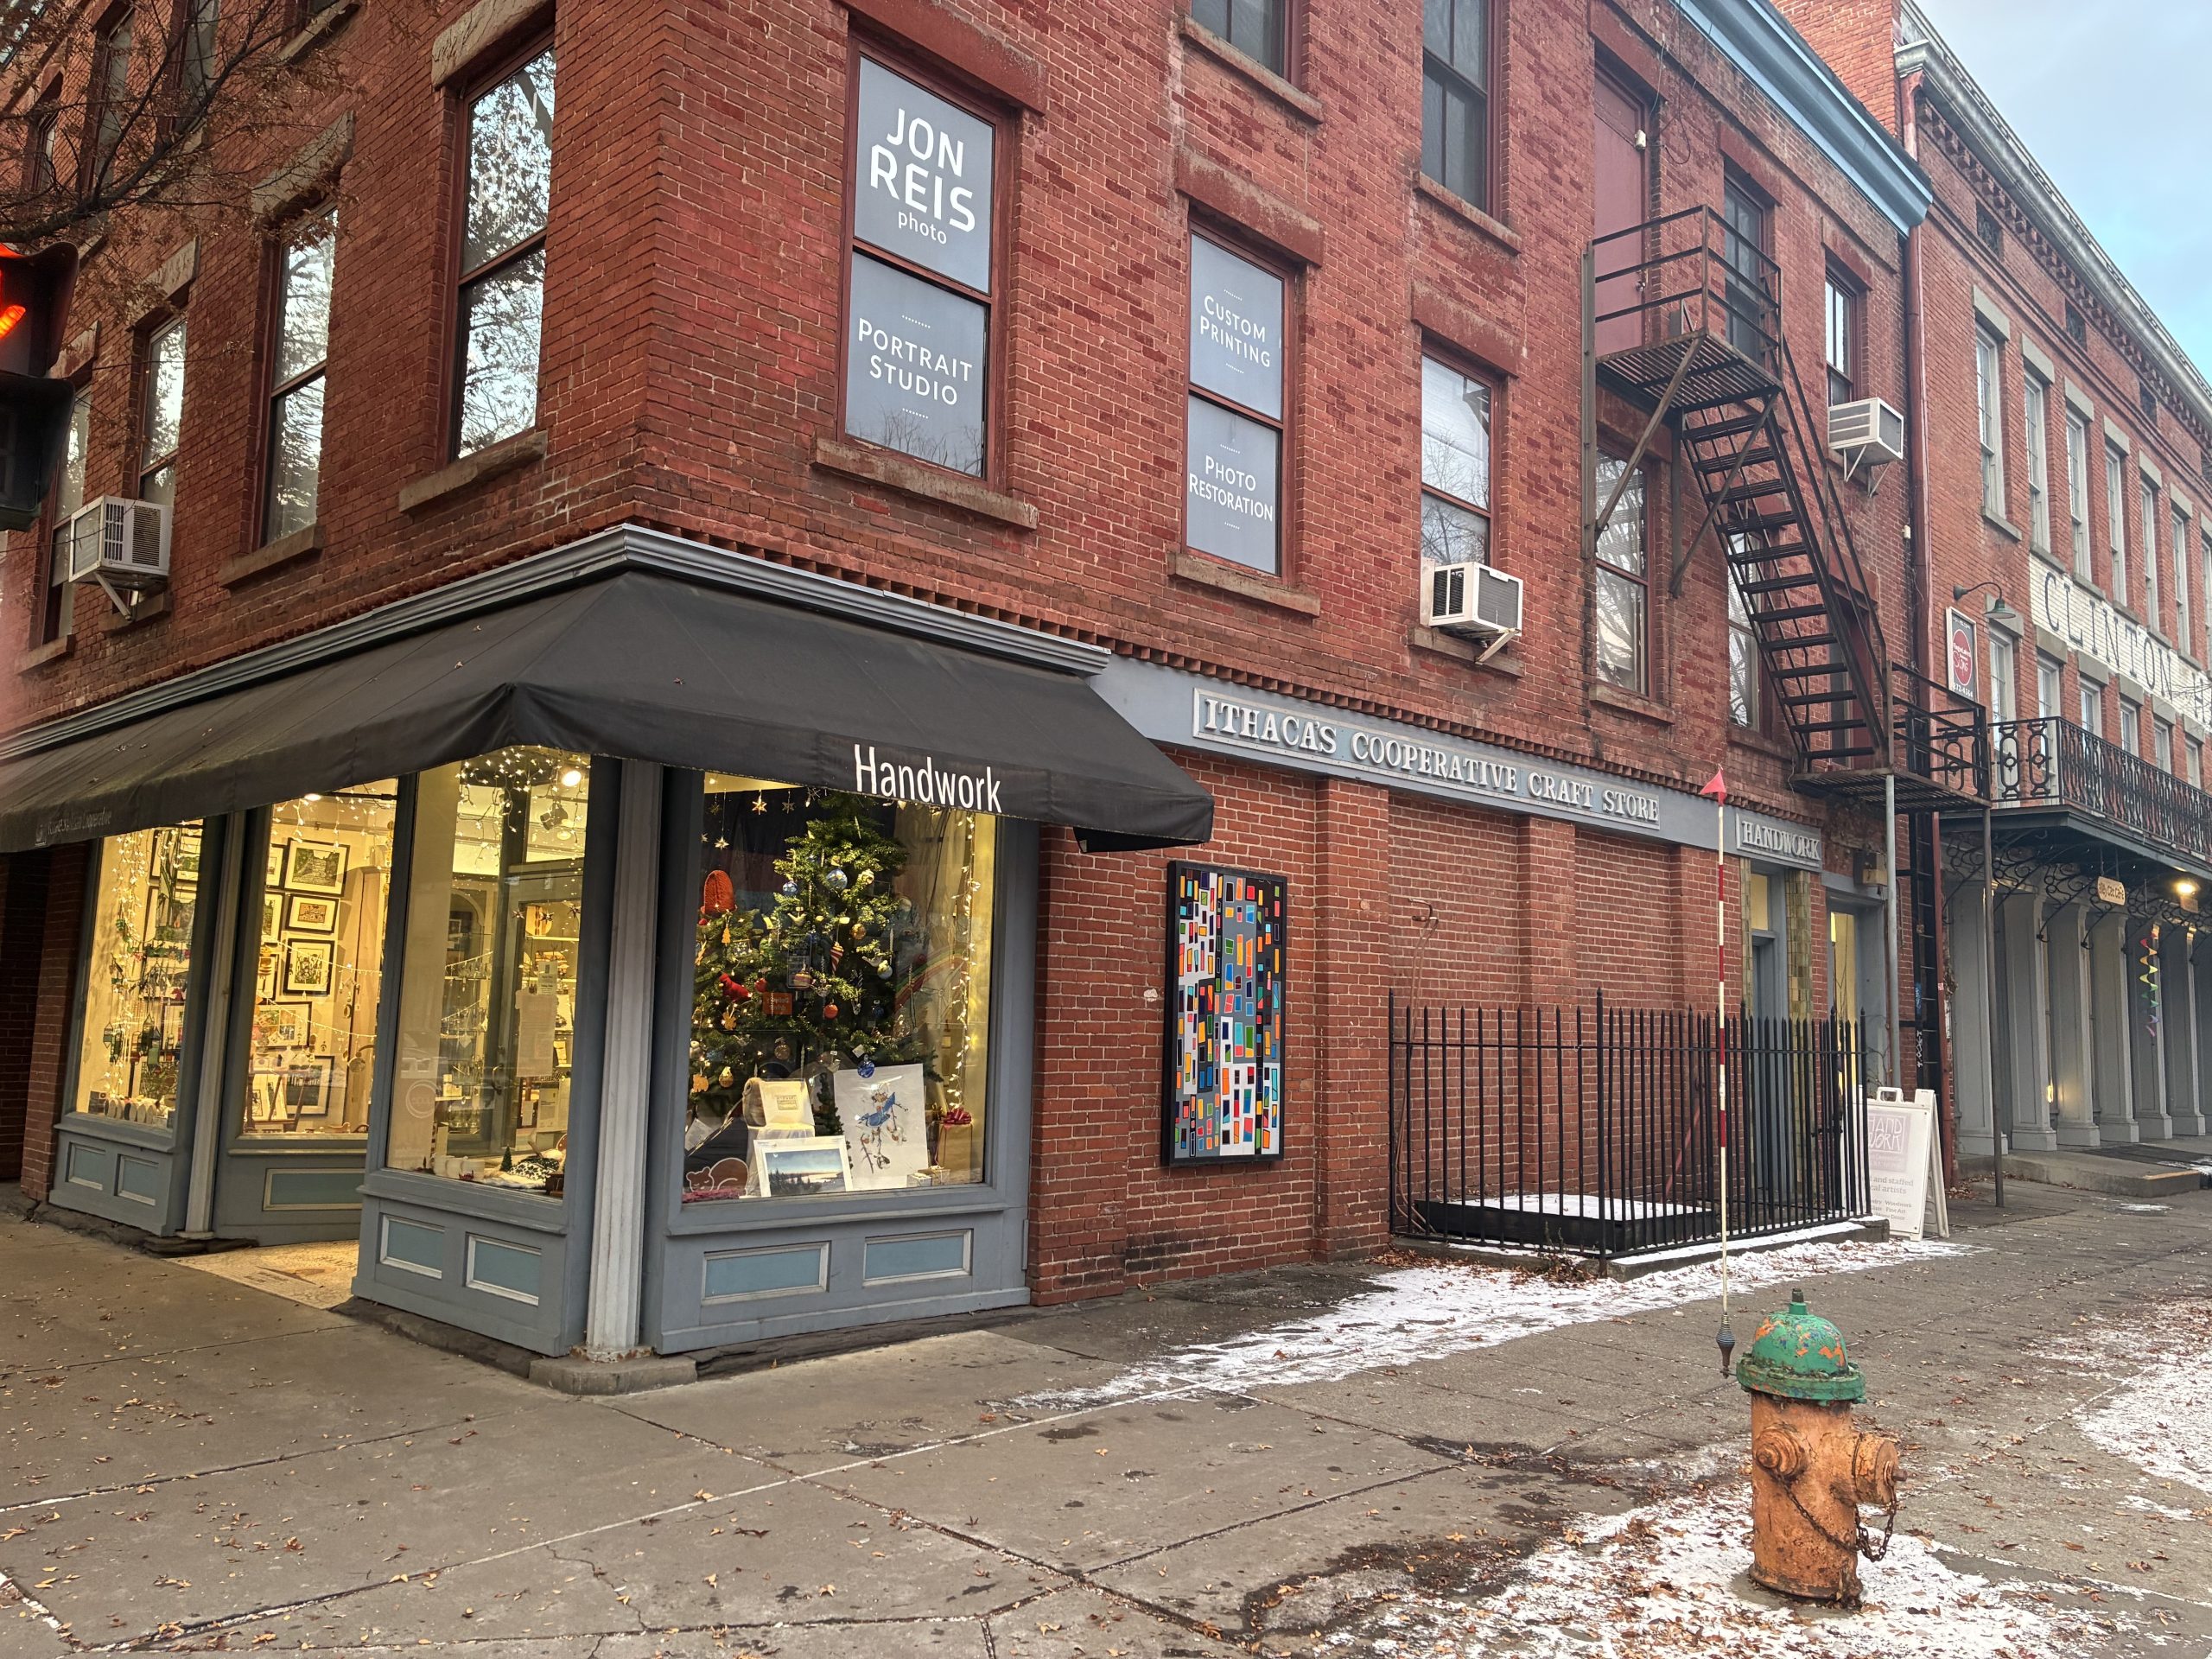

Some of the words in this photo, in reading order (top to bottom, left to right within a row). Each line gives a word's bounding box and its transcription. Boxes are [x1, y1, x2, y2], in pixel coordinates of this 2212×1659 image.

[887, 108, 963, 177] JON
[870, 144, 975, 232] REIS
[898, 211, 947, 245] photo
[1200, 315, 1270, 368] PRINTING
[1204, 295, 1266, 343] CUSTOM
[858, 318, 973, 381] PORTRAIT
[869, 354, 957, 405] STUDIO
[1189, 473, 1274, 523] RESTORATION
[1205, 454, 1256, 493] PHOTO
[2044, 571, 2173, 703] CLINTON
[854, 743, 1002, 813] Handwork
[1205, 698, 1337, 754] ITHACA'S
[1351, 731, 1517, 792] COOPERATIVE
[1527, 772, 1593, 808] CRAFT
[1602, 789, 1659, 822] STORE
[1741, 820, 1821, 861] HANDWORK
